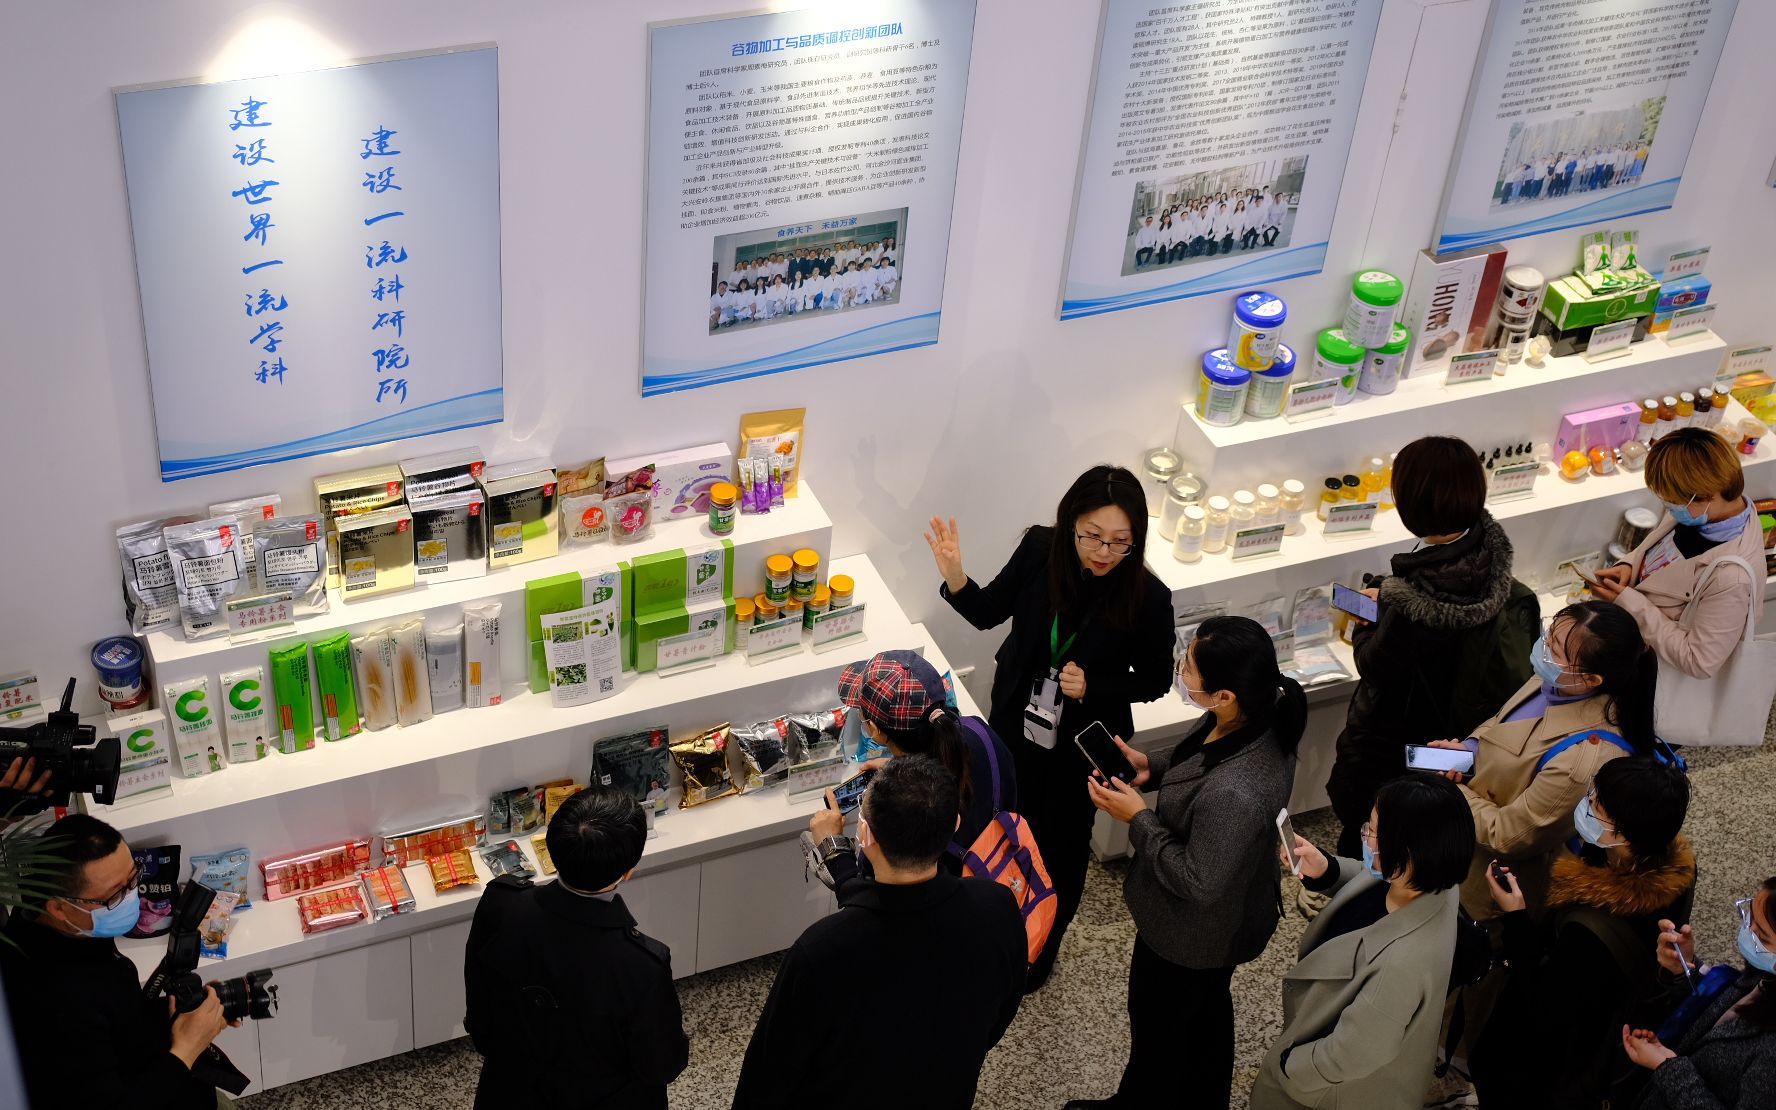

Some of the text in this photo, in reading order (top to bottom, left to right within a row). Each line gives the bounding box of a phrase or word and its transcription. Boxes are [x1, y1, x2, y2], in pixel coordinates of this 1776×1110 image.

[732, 22, 903, 57] 谷物加工与品质调控创新团队
[777, 217, 858, 237] 食养天下 禾益万家
[229, 95, 288, 385] 建设世界一流学科
[360, 125, 409, 405] 建设一流科研院所
[138, 556, 163, 567] Potato
[239, 603, 287, 620] 马铃薯主食
[239, 612, 287, 628] 专用粉系列
[146, 973, 166, 999] anon
